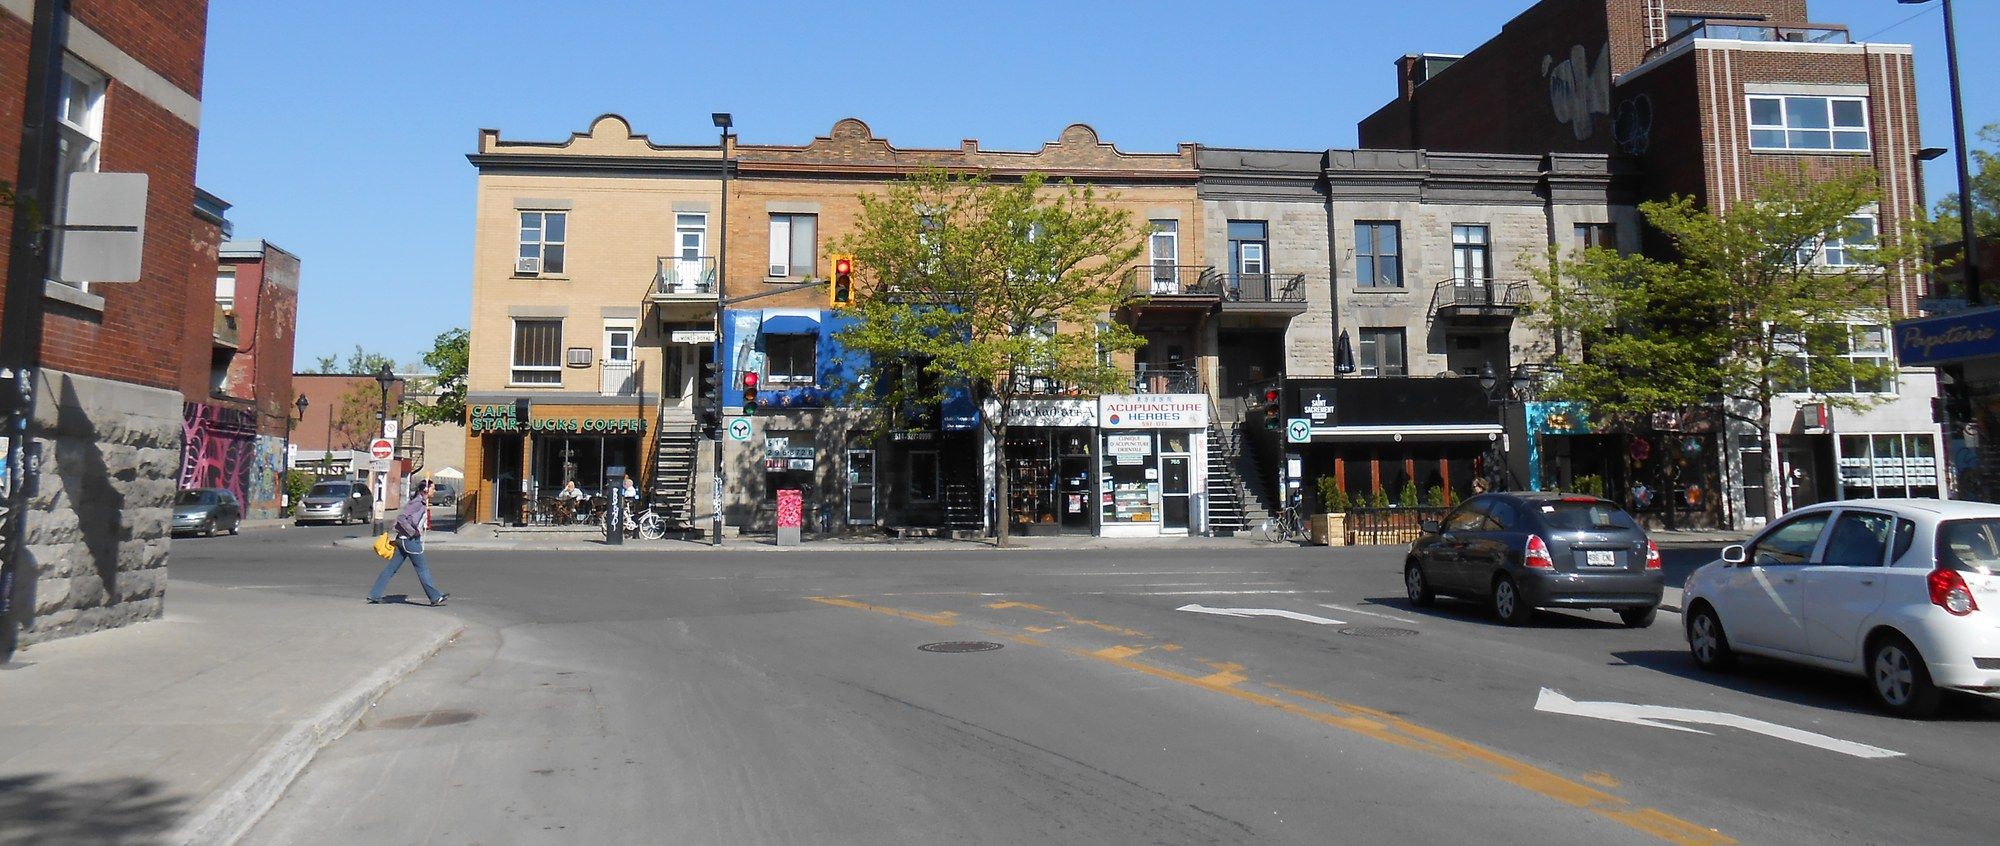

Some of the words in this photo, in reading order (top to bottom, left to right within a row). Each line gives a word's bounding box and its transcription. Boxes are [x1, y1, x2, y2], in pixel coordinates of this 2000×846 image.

[471, 401, 517, 417] CAFÉ
[1107, 403, 1202, 412] ACUPUNCTURE
[1128, 412, 1180, 421] HERBES
[584, 418, 648, 431] COFFEE
